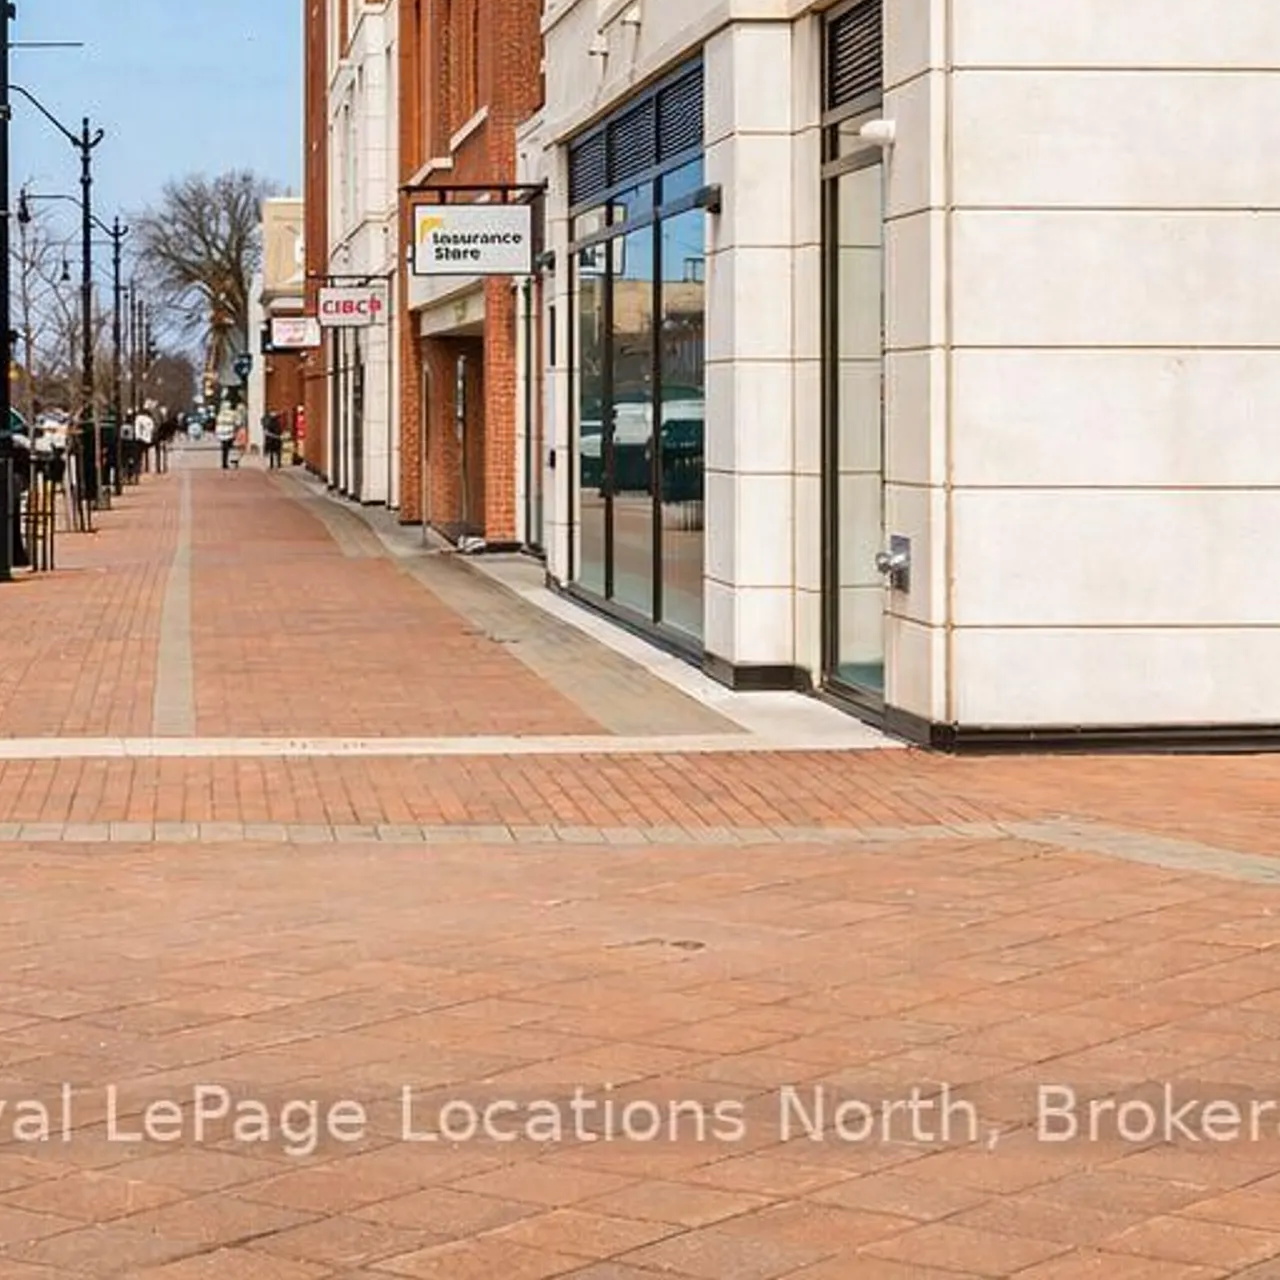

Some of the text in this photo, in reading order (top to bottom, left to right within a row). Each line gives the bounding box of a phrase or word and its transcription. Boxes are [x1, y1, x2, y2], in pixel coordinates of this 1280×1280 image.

[433, 232, 522, 245] Insurance
[435, 246, 481, 261] Store
[322, 299, 368, 314] CIBC
